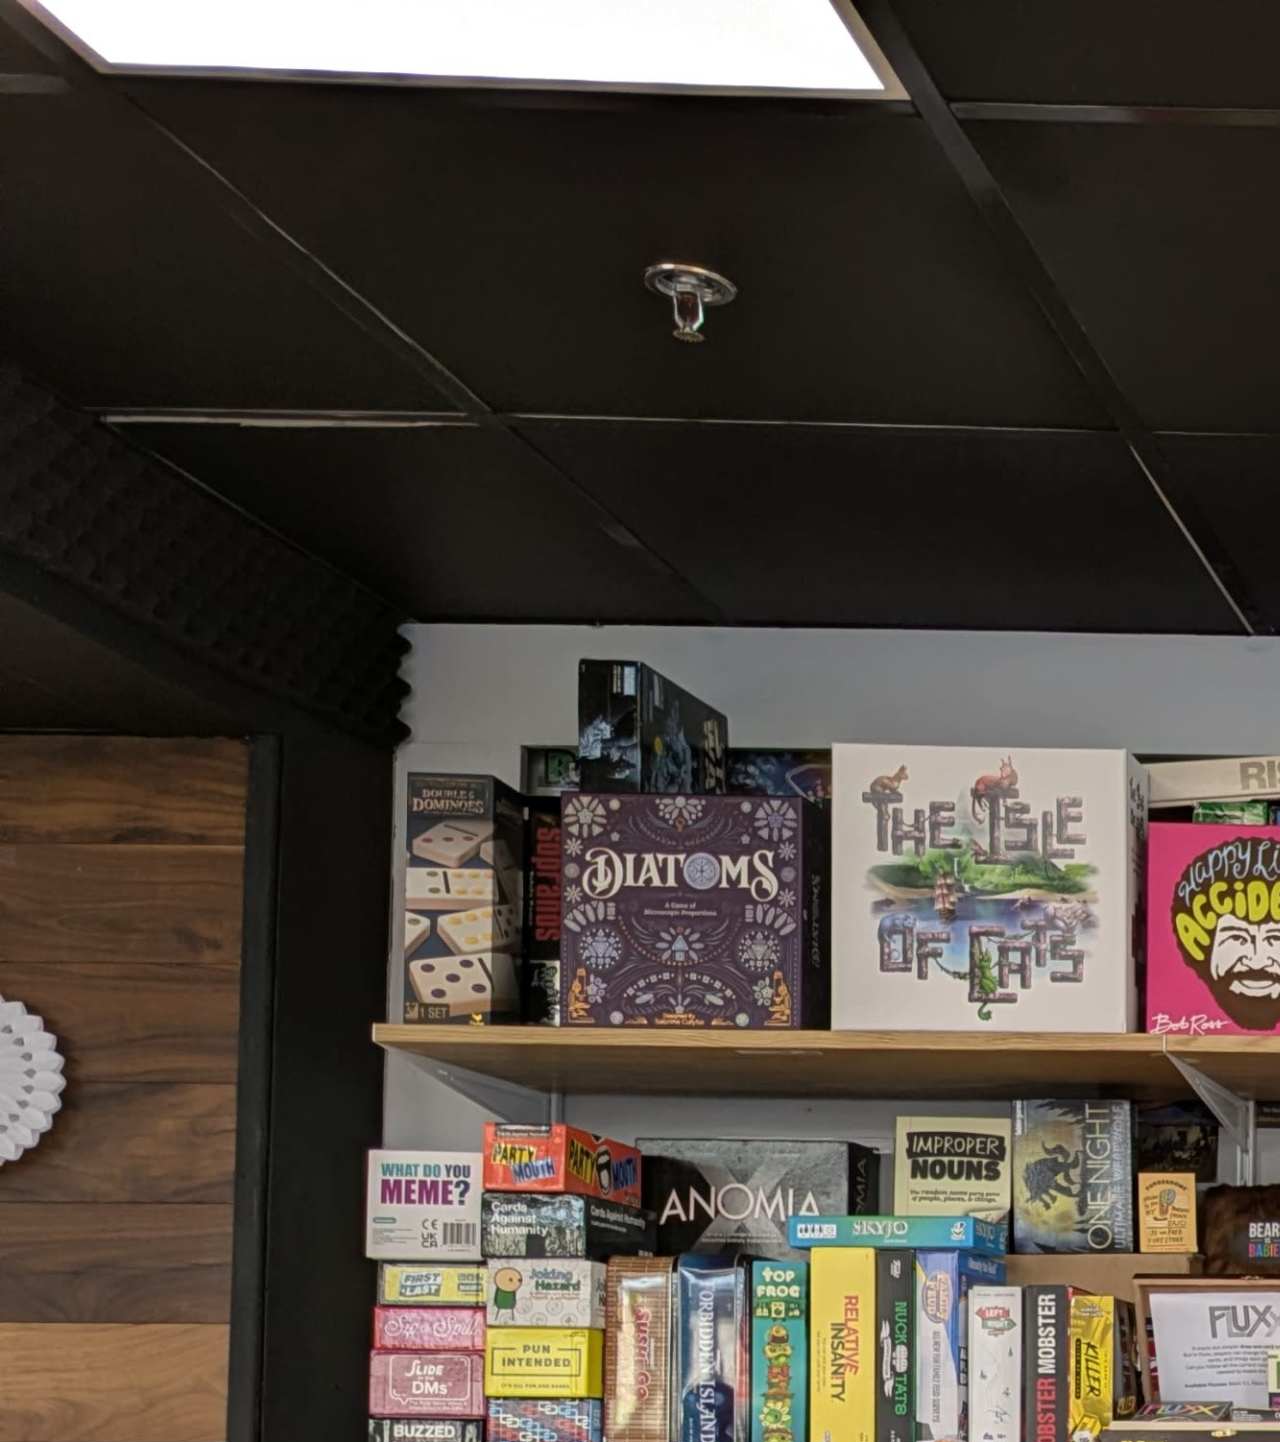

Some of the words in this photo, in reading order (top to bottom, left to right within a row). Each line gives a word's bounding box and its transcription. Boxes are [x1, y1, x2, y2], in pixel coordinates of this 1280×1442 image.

[862, 791, 962, 857] THE
[969, 787, 1087, 864] ISLE
[582, 848, 779, 901] DIATOMS
[1178, 840, 1252, 905] Happy
[878, 914, 951, 980] OF
[968, 919, 1084, 1003] CATS
[428, 1006, 448, 1019] SET
[1150, 1014, 1189, 1035] Bob
[1190, 1014, 1229, 1031] Ross
[492, 1144, 537, 1163] PARTY
[911, 1134, 1001, 1157] IMPROPER
[1084, 1103, 1110, 1189] NIGHT
[381, 1163, 419, 1177] WHAT
[422, 1163, 441, 1177] DO
[445, 1164, 471, 1178] YOU
[512, 1158, 555, 1181] MOUTH
[910, 1159, 1001, 1181] NOUNS
[380, 1179, 471, 1205] MEME?
[491, 1201, 528, 1213] Cards
[659, 1183, 820, 1224] ANOMIA
[491, 1213, 537, 1226] Against
[1087, 1196, 1112, 1249] ONE
[491, 1224, 549, 1238] Humanity
[761, 1266, 796, 1282] TOP
[756, 1284, 801, 1298] FROG
[843, 1295, 860, 1375] RELATIVE
[1037, 1293, 1056, 1374] MOBSTER
[522, 1344, 552, 1354] PUN
[501, 1356, 572, 1368] INTENDED
[830, 1322, 846, 1403] INSANITY
[412, 1380, 448, 1395] DMs
[394, 1426, 456, 1439] BUZZED
